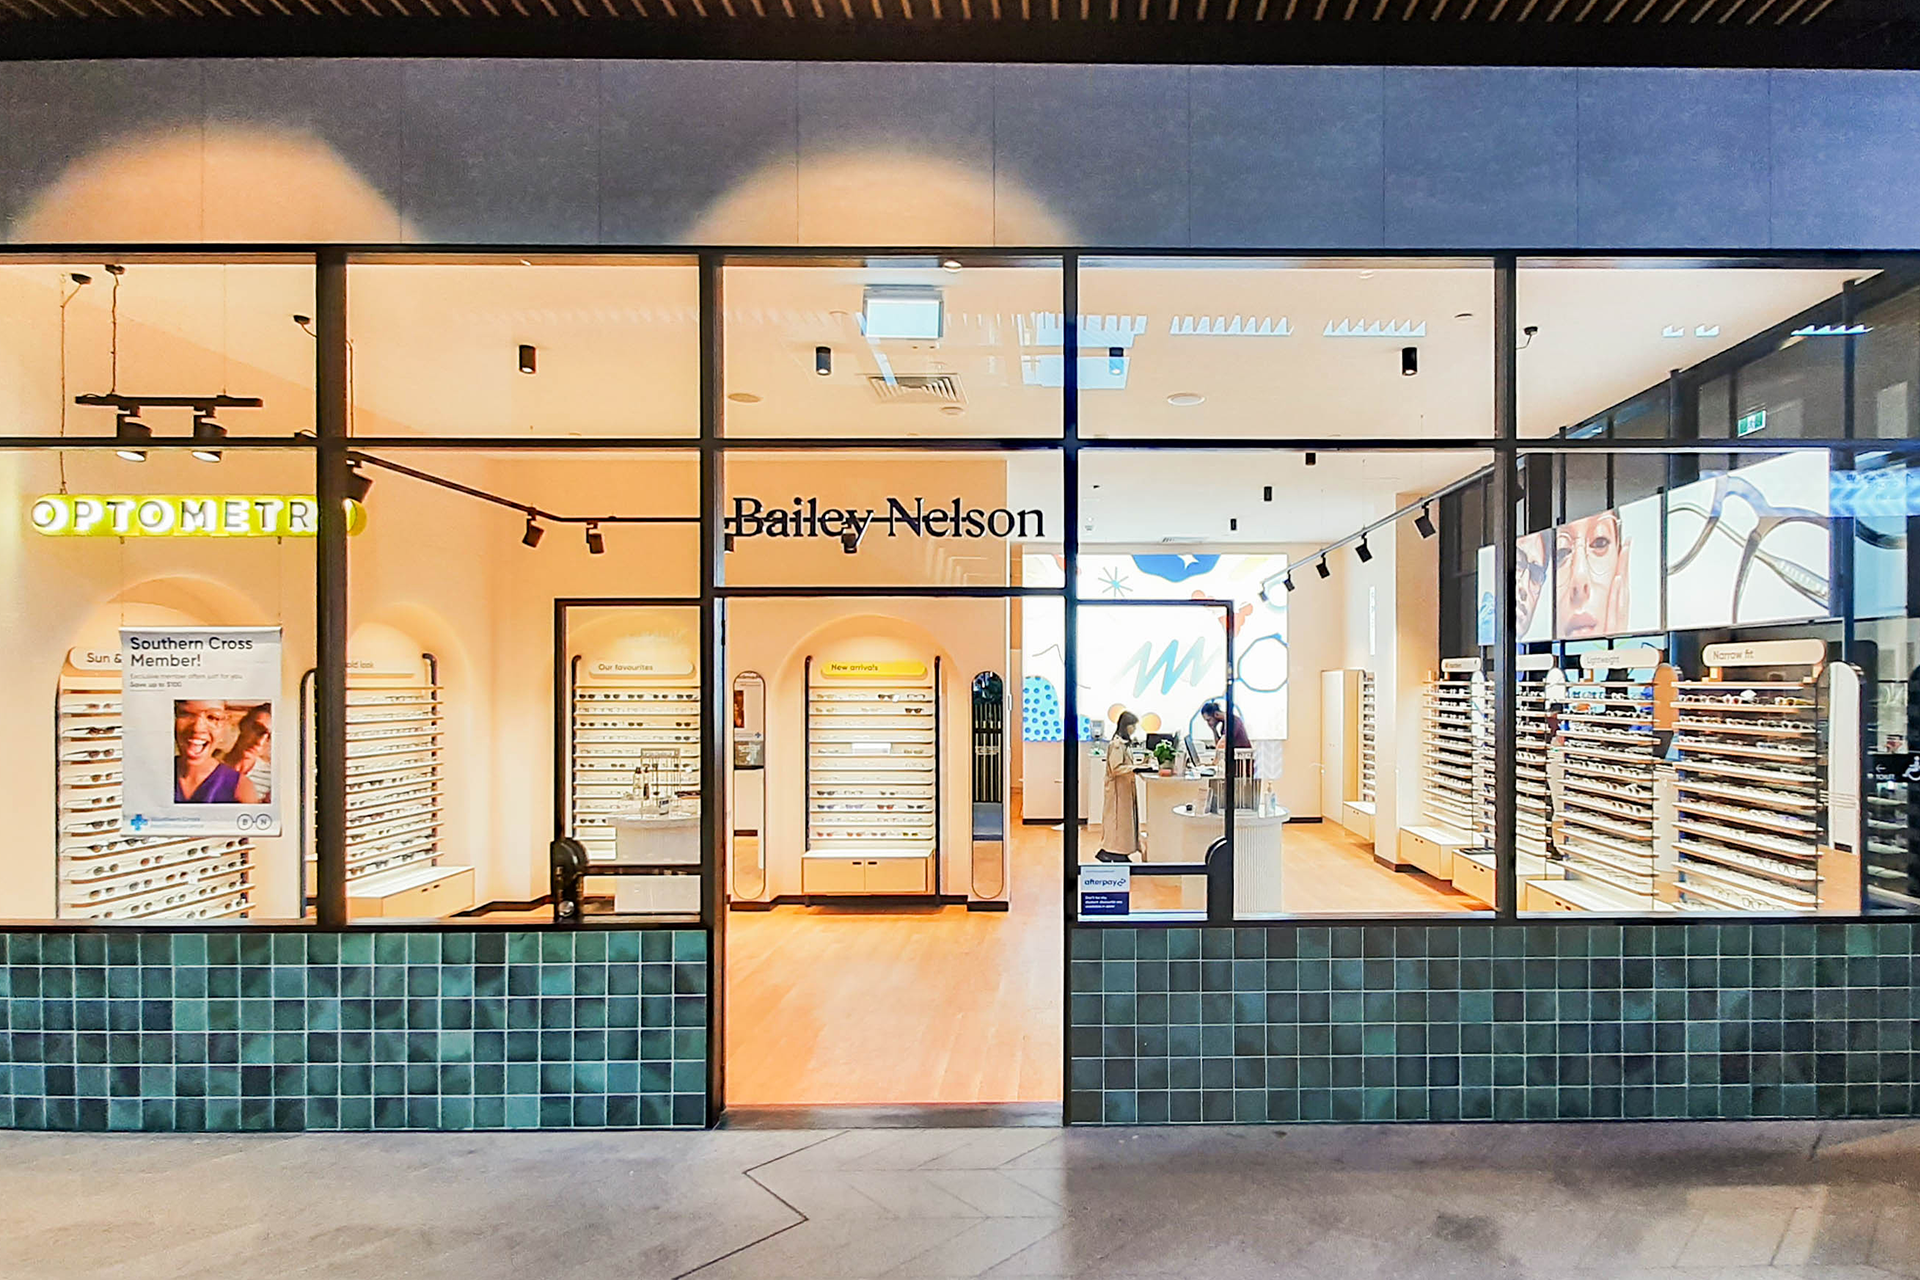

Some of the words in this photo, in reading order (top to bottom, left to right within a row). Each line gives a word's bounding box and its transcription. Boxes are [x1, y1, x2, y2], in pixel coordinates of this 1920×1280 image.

[31, 499, 315, 531] OPTOMETR
[733, 497, 874, 546] Bailey
[886, 497, 1045, 538] Nelson
[130, 637, 204, 650] Southern
[208, 637, 253, 650] Cross
[86, 652, 110, 664] Sun
[130, 654, 201, 667] Member!
[1713, 650, 1743, 660] Narrow
[1745, 649, 1755, 659] fit
[598, 663, 613, 671] Our
[614, 663, 653, 671] favourites
[1084, 878, 1117, 887] afterpay
